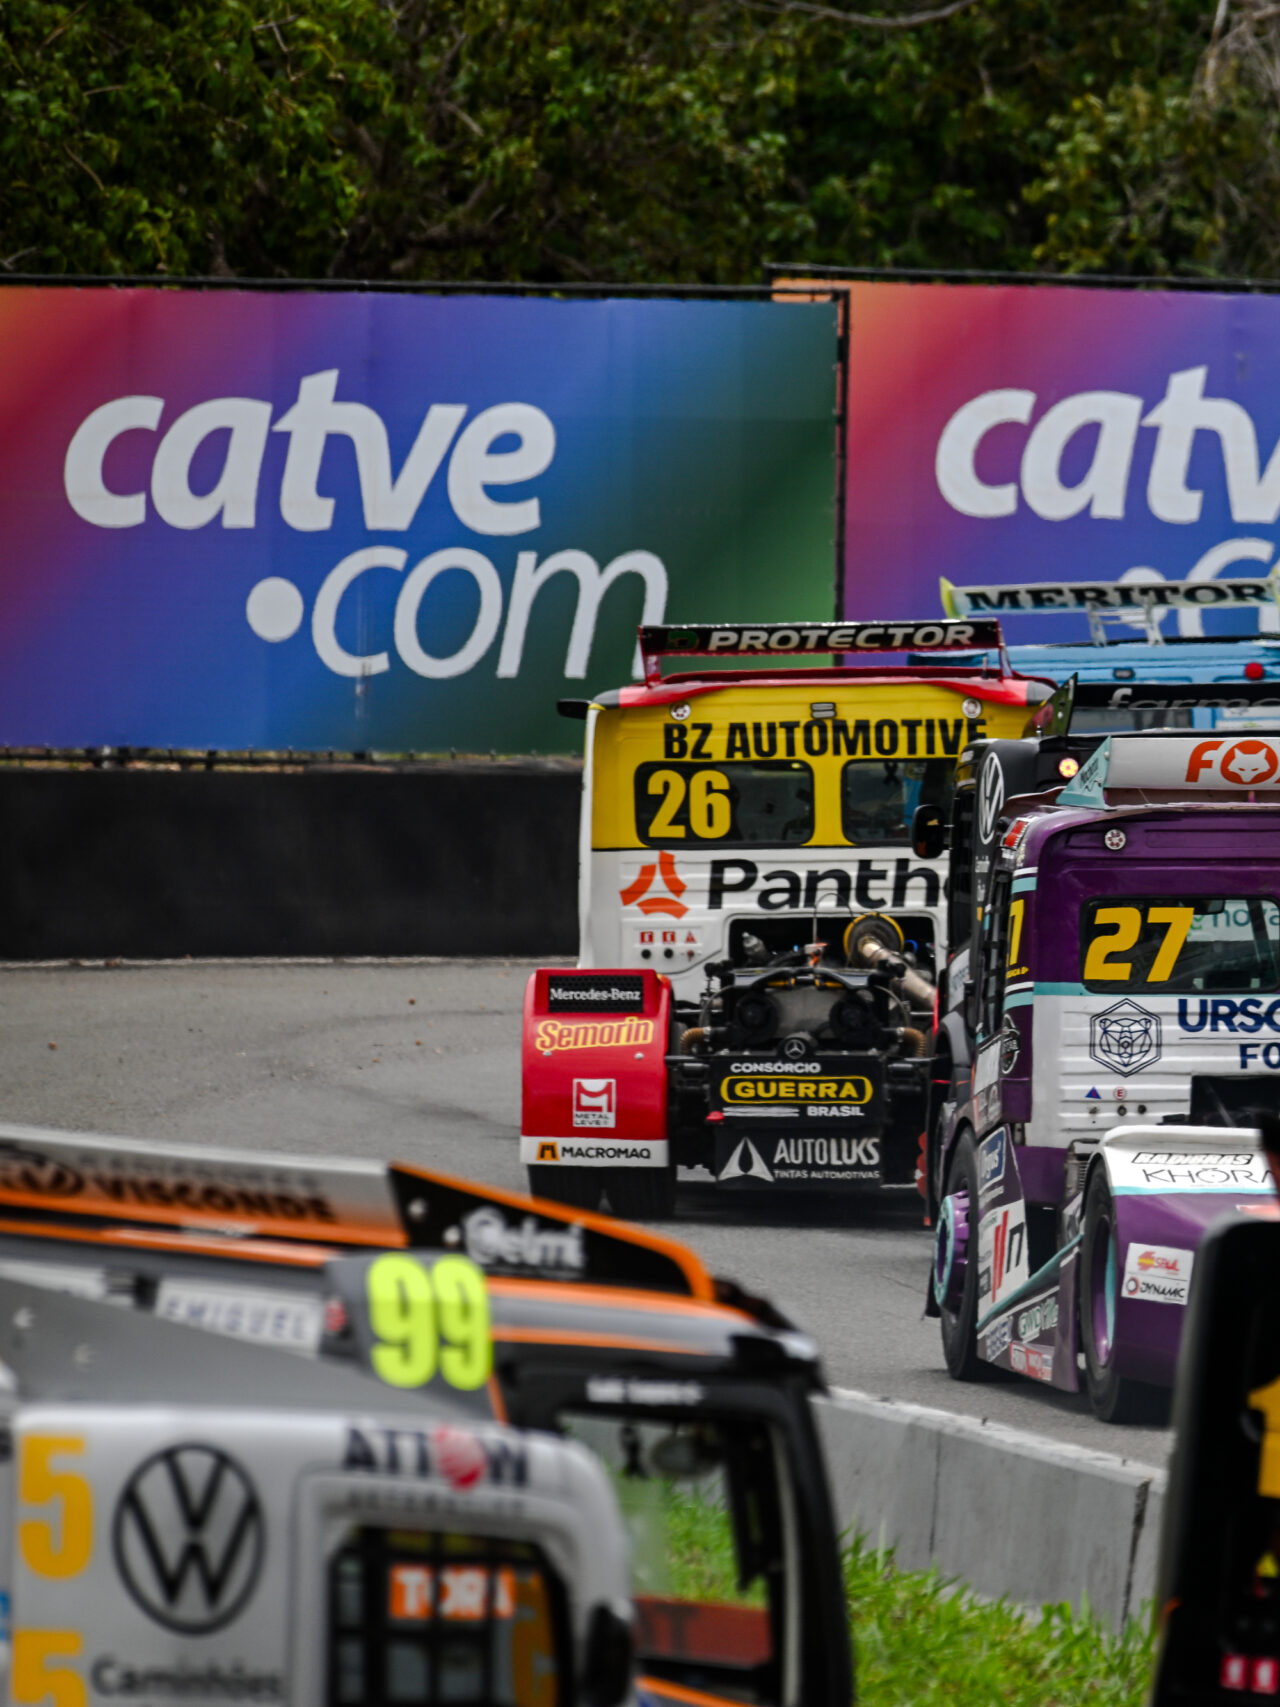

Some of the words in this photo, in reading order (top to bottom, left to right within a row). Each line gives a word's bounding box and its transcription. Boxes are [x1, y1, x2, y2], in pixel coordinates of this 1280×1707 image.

[63, 368, 557, 536] catve
[245, 545, 669, 679] .com
[964, 582, 1269, 615] MERITOR
[707, 625, 976, 651] PROTECTOR
[663, 721, 713, 759] BZ
[647, 769, 731, 839] 26
[707, 858, 949, 910] Panth
[1083, 906, 1195, 982] 27
[549, 988, 641, 1001] Mercedes-Benz
[535, 1016, 654, 1052] Semorin
[730, 1061, 822, 1074] CONSÓRCIO
[733, 1081, 860, 1099] GUERRA
[806, 1105, 866, 1117] BRASIL
[561, 1146, 652, 1159] MACROMAQ
[773, 1137, 881, 1166] AUTOLUKS
[773, 1168, 809, 1179] TINTAS
[810, 1169, 880, 1180] AUTOMOTIVAS
[367, 1251, 492, 1390] 99
[17, 1435, 94, 1581] 5
